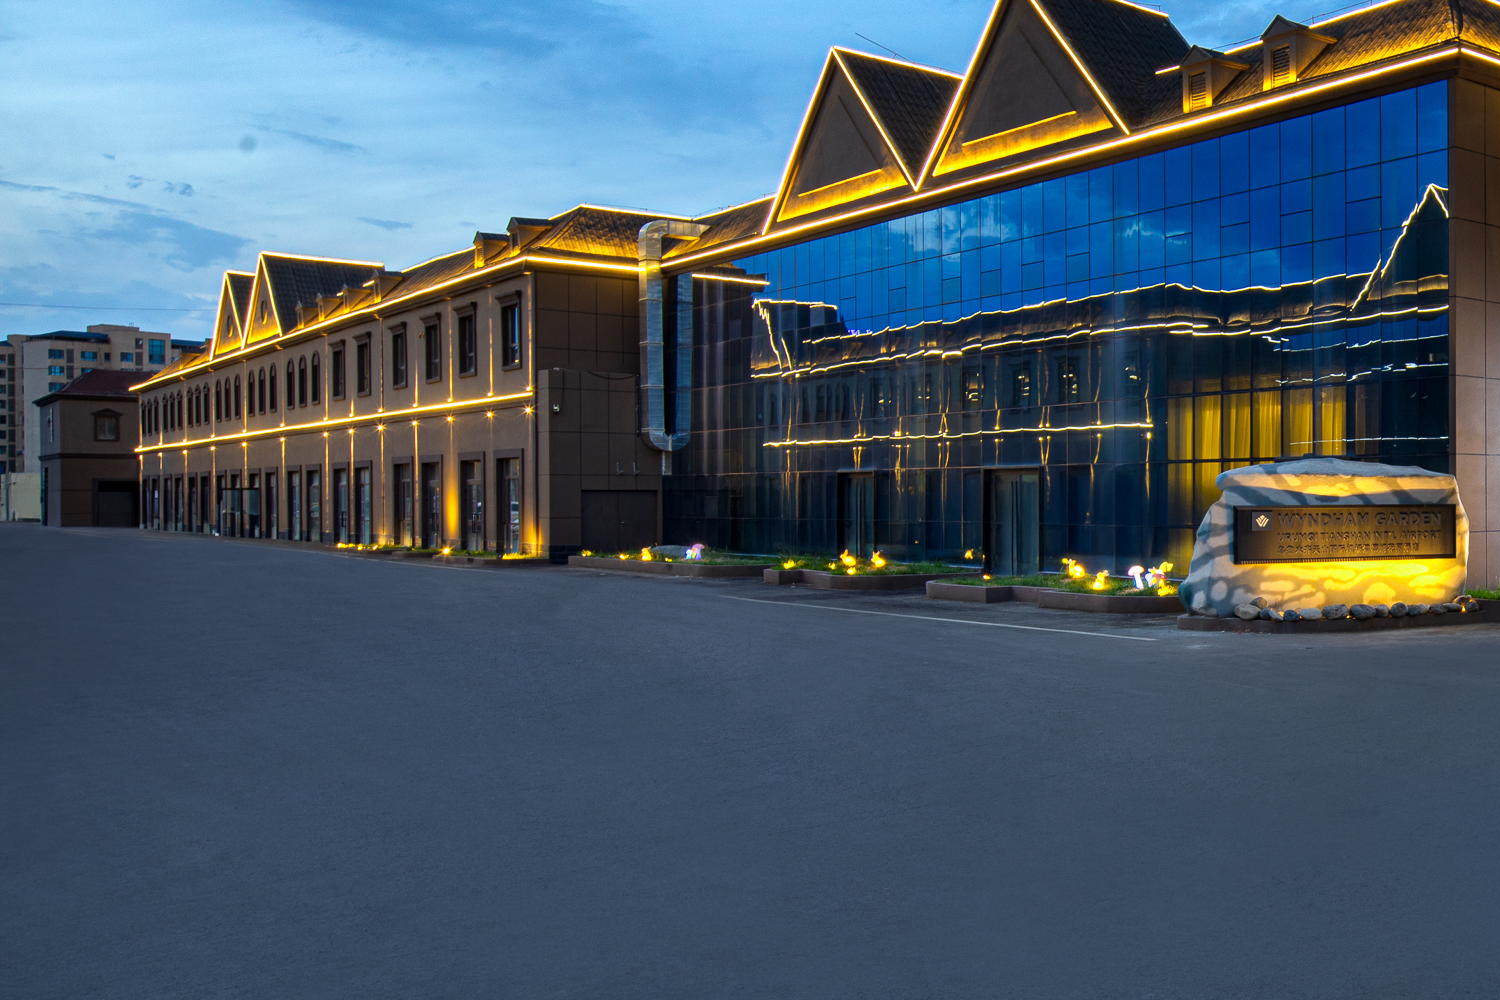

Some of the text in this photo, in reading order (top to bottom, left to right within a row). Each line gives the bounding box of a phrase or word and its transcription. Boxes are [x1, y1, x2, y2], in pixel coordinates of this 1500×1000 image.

[1277, 511, 1442, 528] WYNDHAM GARDEN
[1277, 532, 1318, 542] URUMQI
[1320, 531, 1371, 542] TIANSHAN
[1400, 530, 1442, 541] AIRPORT
